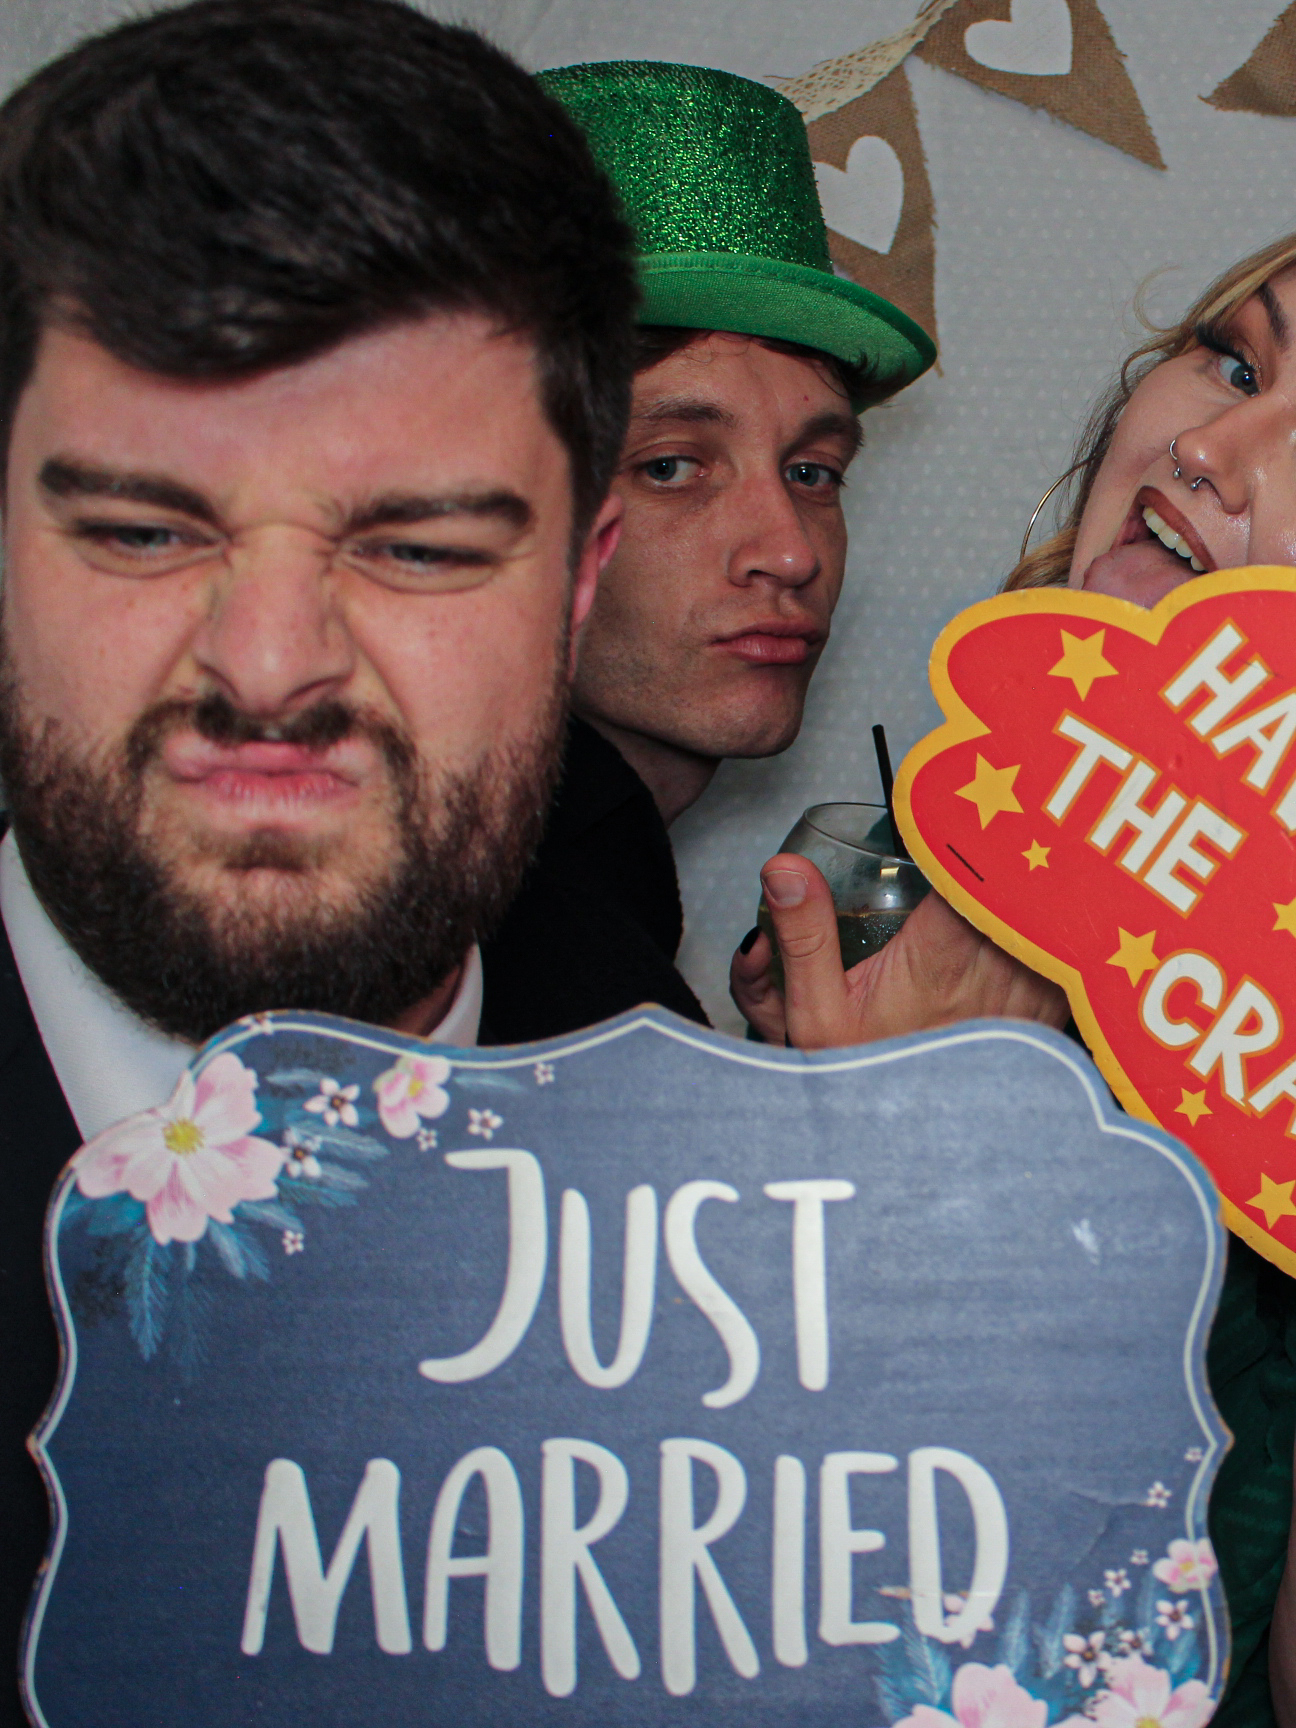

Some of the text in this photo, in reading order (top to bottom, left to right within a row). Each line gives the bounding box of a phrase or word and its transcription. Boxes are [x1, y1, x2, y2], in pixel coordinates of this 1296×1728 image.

[1041, 709, 1247, 917] THE
[418, 1148, 857, 1409] JUST
[240, 1437, 1008, 1698] MARRIED
